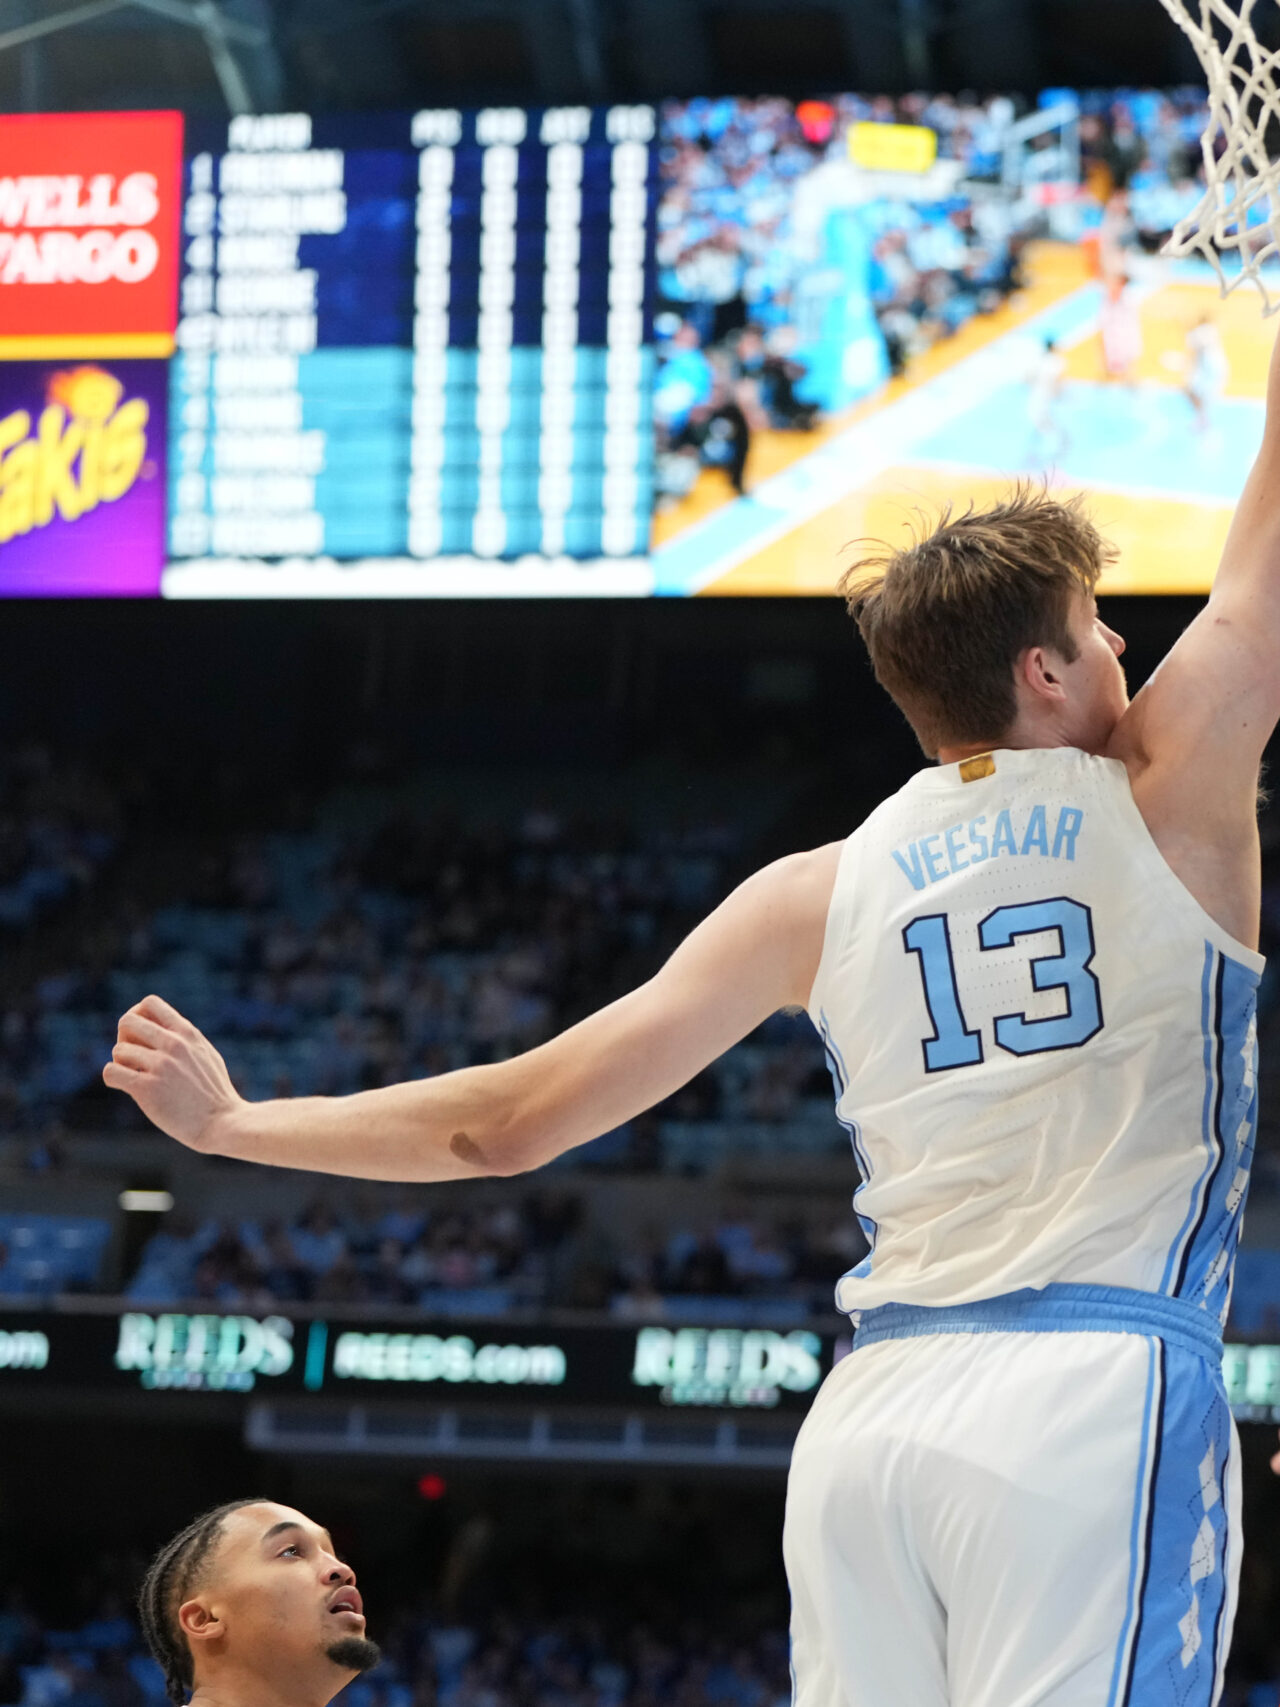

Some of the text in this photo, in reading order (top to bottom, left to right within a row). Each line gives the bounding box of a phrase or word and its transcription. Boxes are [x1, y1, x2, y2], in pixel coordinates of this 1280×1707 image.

[0, 228, 160, 284] ARGO
[891, 805, 1084, 891] VEESAAR
[902, 896, 1105, 1074] 13
[115, 1313, 294, 1377] REEDS
[632, 1327, 822, 1393] REEDS
